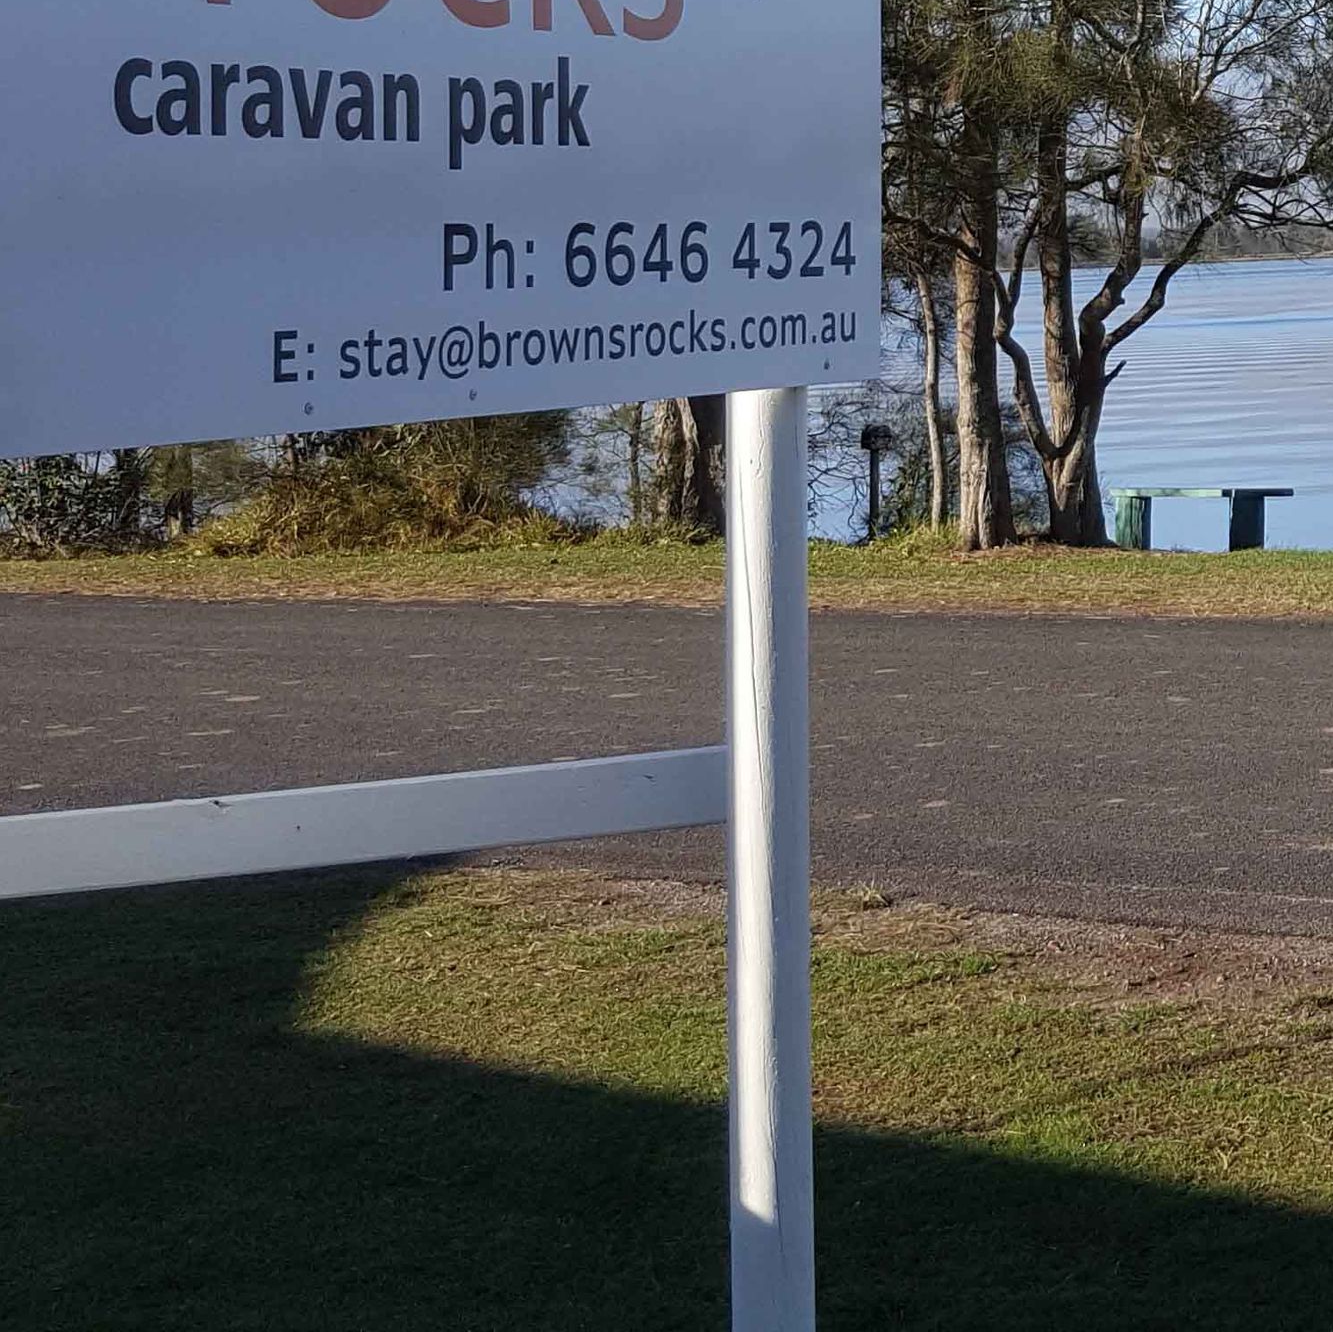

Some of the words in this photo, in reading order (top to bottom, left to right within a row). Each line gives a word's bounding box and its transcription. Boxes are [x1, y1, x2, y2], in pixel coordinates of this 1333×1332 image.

[113, 57, 420, 142] caravan
[448, 56, 591, 170] park
[443, 222, 535, 292] Ph:
[564, 221, 709, 288] 6646
[732, 220, 857, 280] 4324
[273, 329, 315, 384] E:
[339, 307, 857, 380] stay@brownsrocks.com.au
